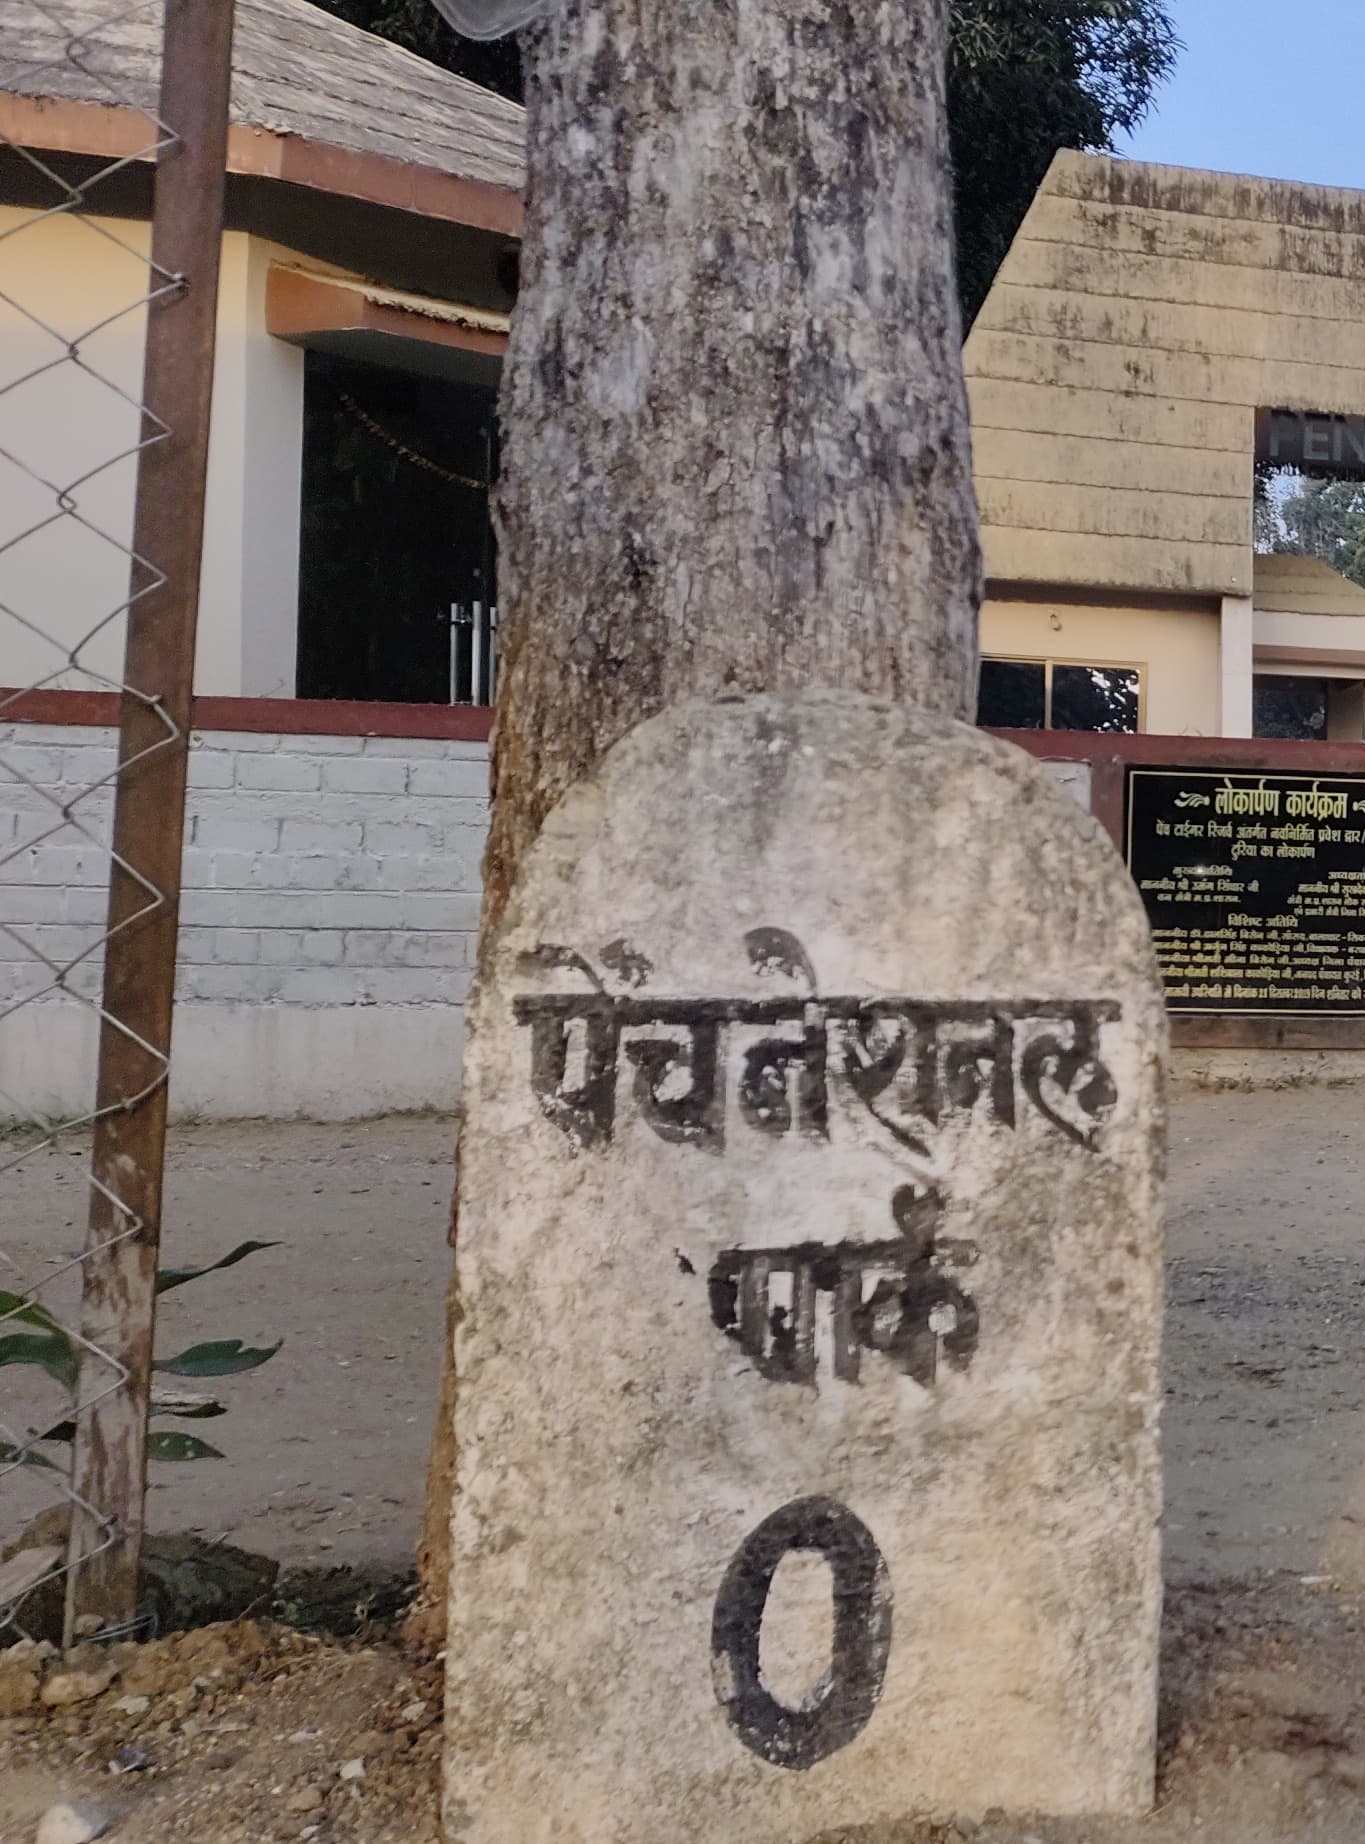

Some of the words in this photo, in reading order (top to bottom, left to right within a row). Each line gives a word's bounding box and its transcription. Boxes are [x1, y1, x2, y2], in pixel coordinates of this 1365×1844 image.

[1214, 777, 1281, 817] लोकार्पण
[1285, 781, 1348, 821] कार्यक्रम
[1174, 820, 1204, 838] टाईगर
[1208, 820, 1233, 838] रिजर्व
[1236, 822, 1267, 839] अंतर्गत
[1270, 822, 1315, 840] नवनिर्मित
[1318, 825, 1341, 842] प्रवेश
[1231, 840, 1257, 861] टुरिया
[1260, 846, 1274, 857] का
[1276, 842, 1315, 859] लोकार्पण
[1177, 878, 1189, 891] श्री
[1227, 913, 1263, 927] विशिष्ट
[1265, 915, 1299, 928] अतिथि
[706, 1183, 981, 1392] पार्क
[711, 1495, 894, 1770] 0
